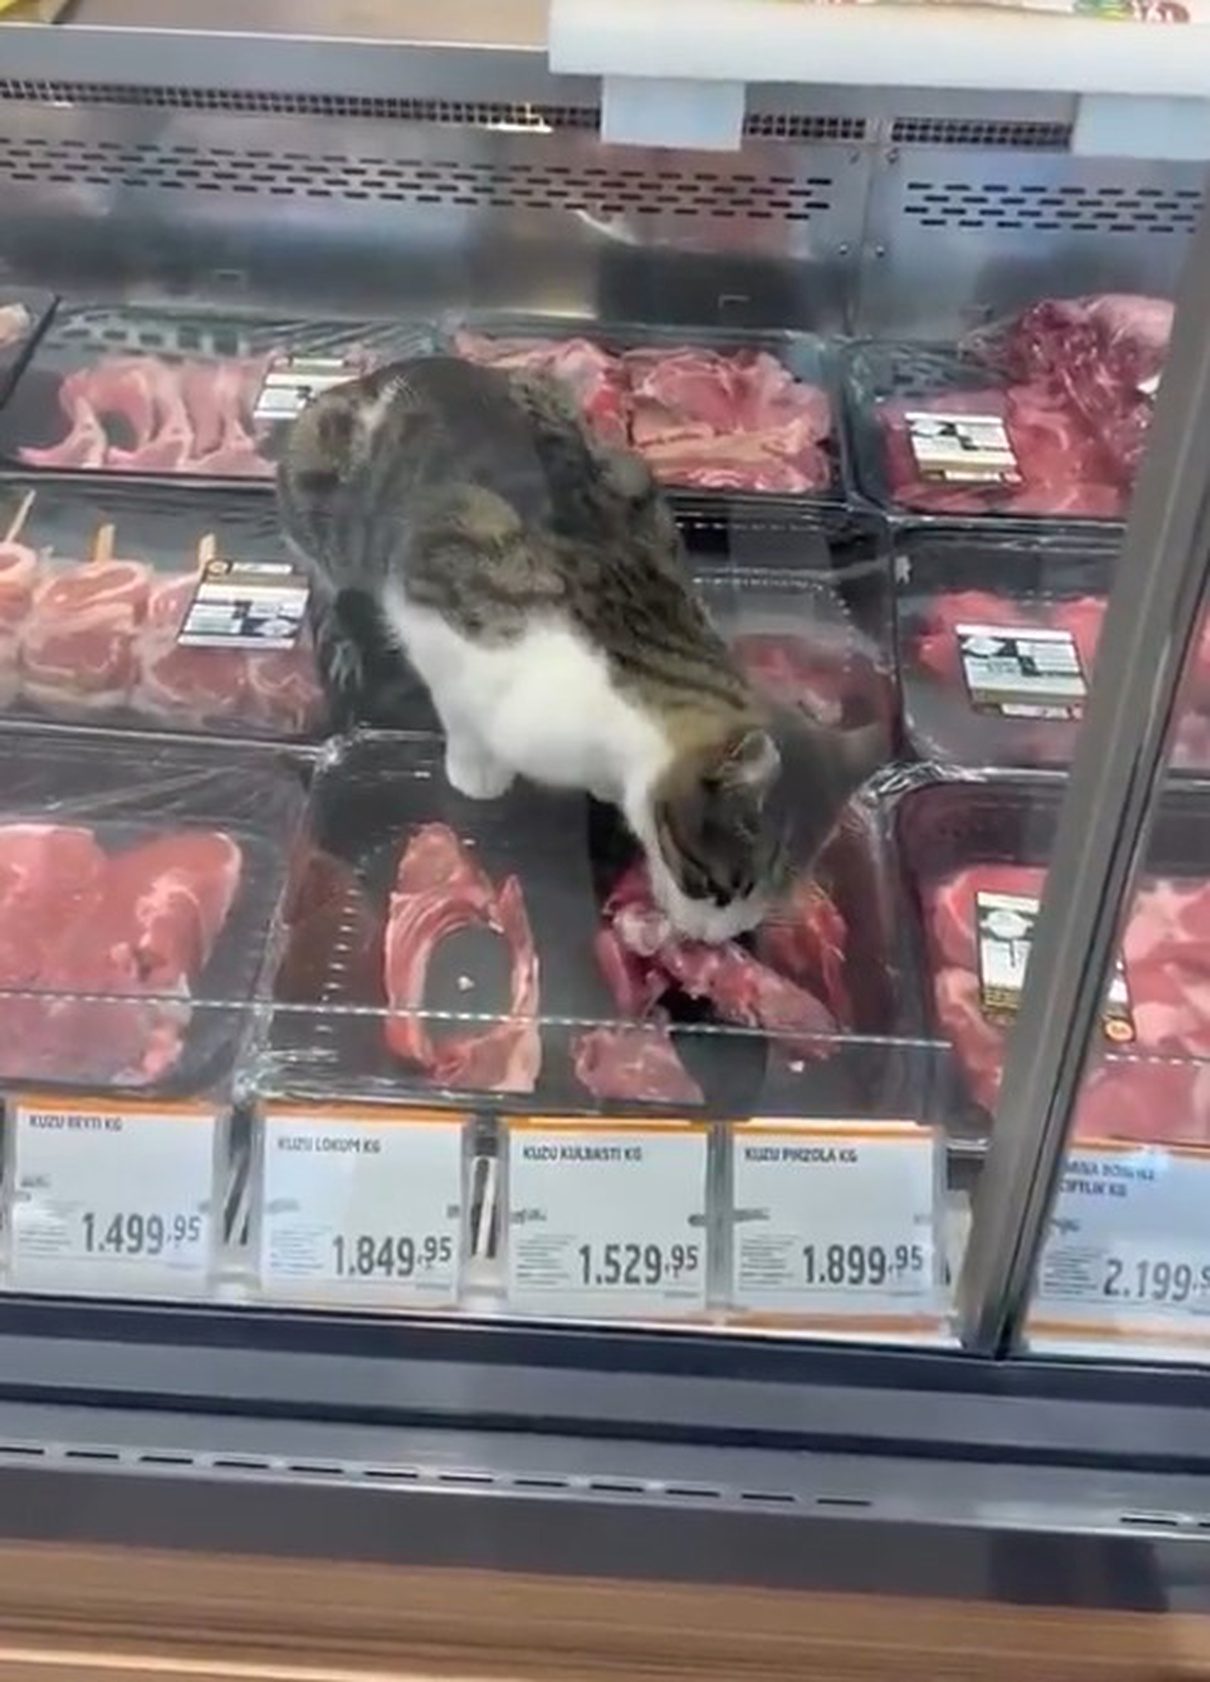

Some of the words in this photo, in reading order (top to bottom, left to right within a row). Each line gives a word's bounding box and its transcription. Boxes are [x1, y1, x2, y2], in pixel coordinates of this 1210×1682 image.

[29, 1114, 65, 1129] KUZU
[104, 1117, 123, 1131] KG
[363, 1139, 381, 1153] KG
[523, 1145, 558, 1160] KUZU
[624, 1146, 642, 1161] KG
[745, 1147, 780, 1162] KUZU
[839, 1148, 858, 1163] KG
[83, 1212, 201, 1254] 1.499,95
[333, 1235, 452, 1277] 1.849,95
[579, 1243, 699, 1285] 1.529,95
[803, 1244, 923, 1285] 1.899,95
